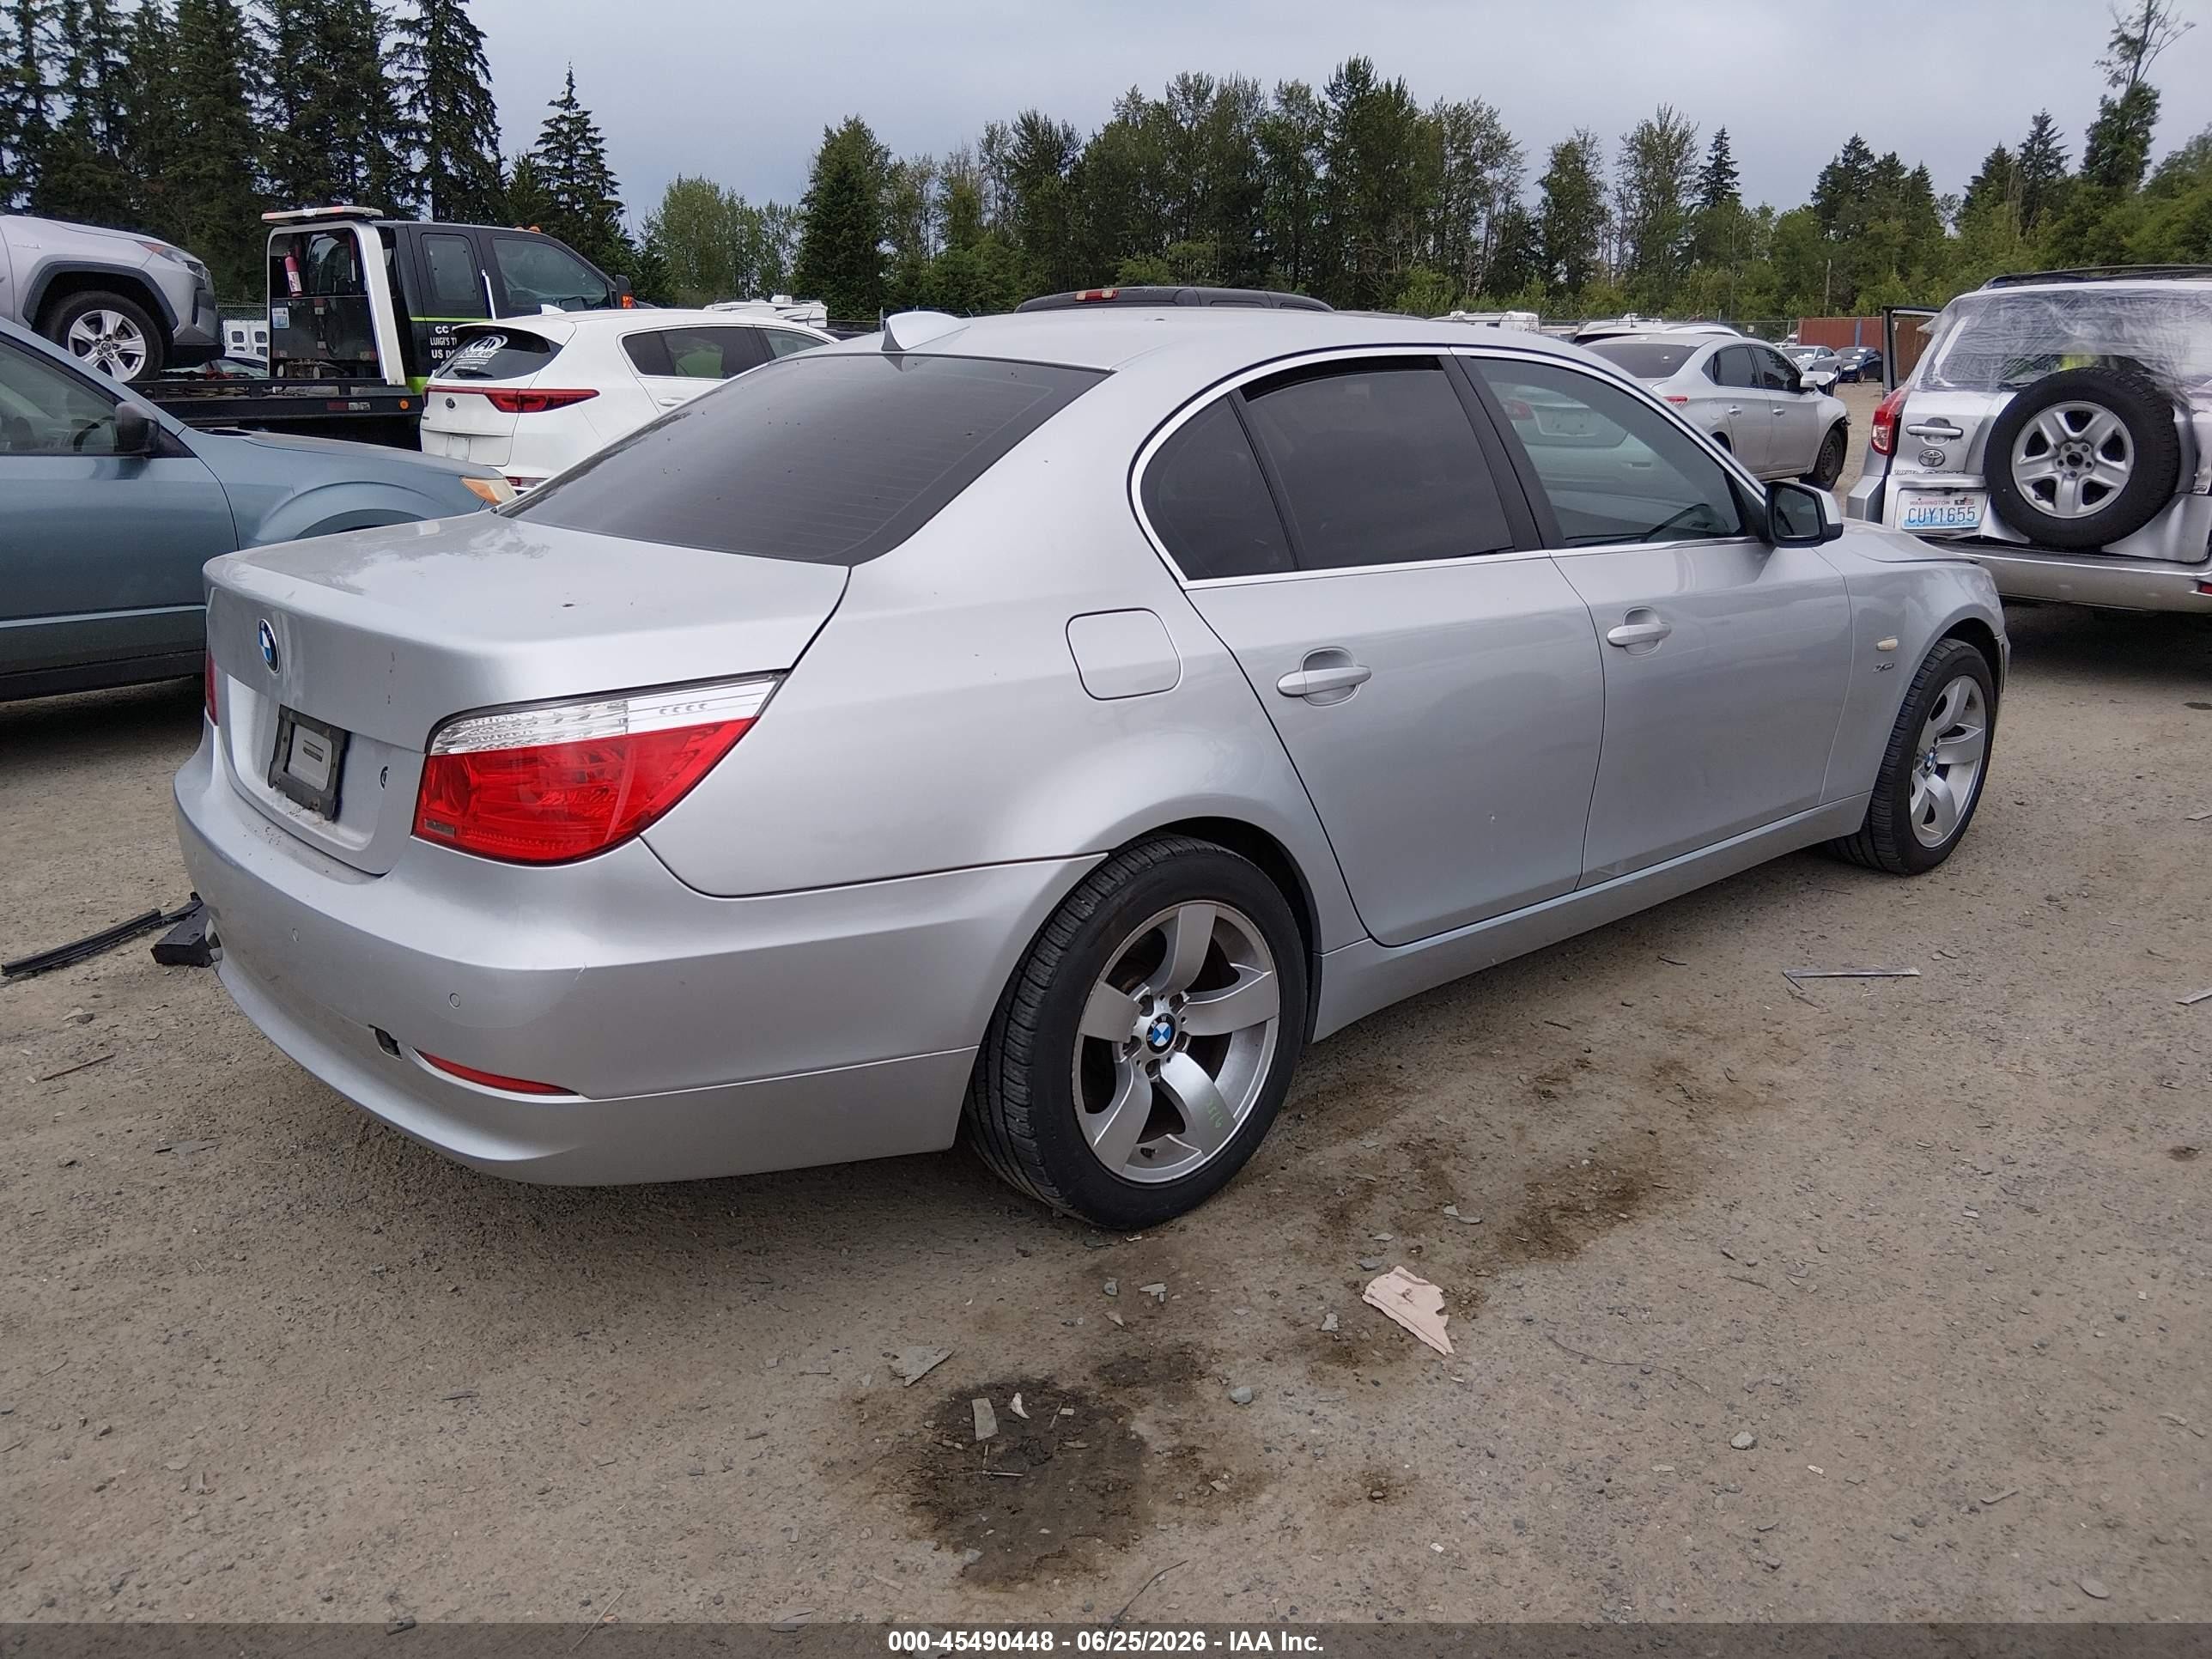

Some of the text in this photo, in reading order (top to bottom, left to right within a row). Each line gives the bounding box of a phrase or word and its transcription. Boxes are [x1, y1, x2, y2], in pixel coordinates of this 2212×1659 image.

[434, 325, 449, 334] CC
[429, 337, 450, 346] LUIGI'S
[431, 349, 443, 359] US
[1908, 507, 1976, 523] CUY1655
